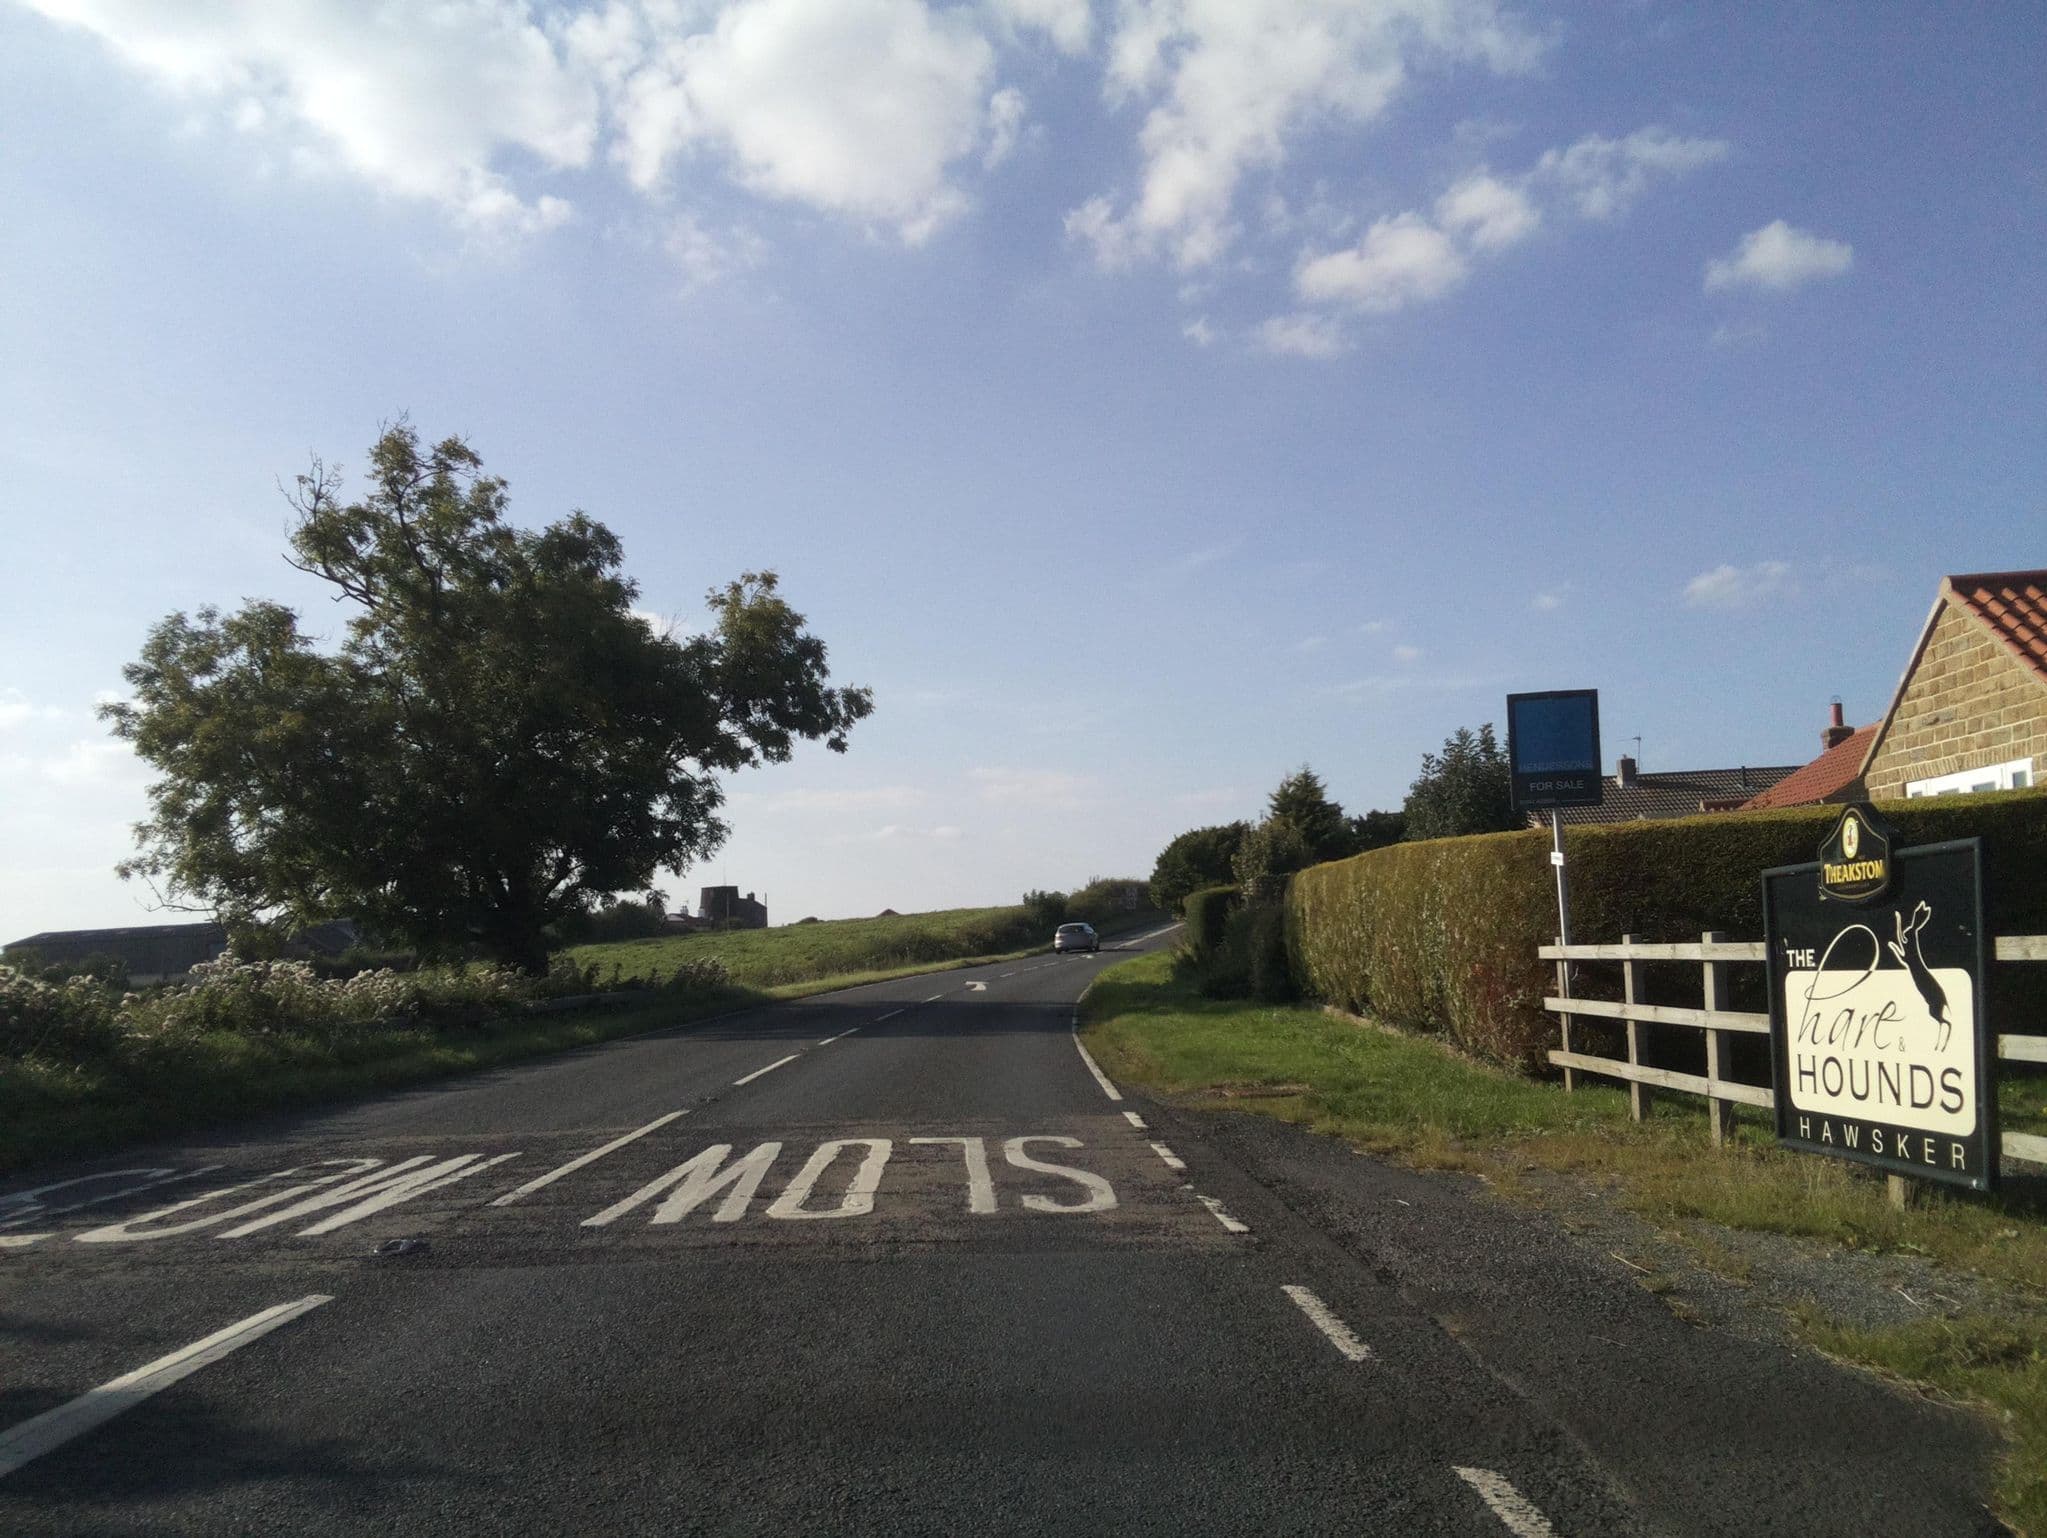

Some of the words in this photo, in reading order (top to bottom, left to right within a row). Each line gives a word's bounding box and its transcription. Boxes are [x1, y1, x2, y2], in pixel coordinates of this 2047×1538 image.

[1529, 781, 1553, 792] FOR
[1556, 779, 1584, 791] SALE
[1824, 859, 1884, 885] THEAKSTON
[1786, 949, 1816, 967] THE
[1798, 924, 1906, 1051] hare
[1898, 1037, 1905, 1052] &
[1797, 1054, 1965, 1115] HOUNDS
[1800, 1116, 1966, 1170] HAWSKER
[581, 1136, 1118, 1226] SLOW
